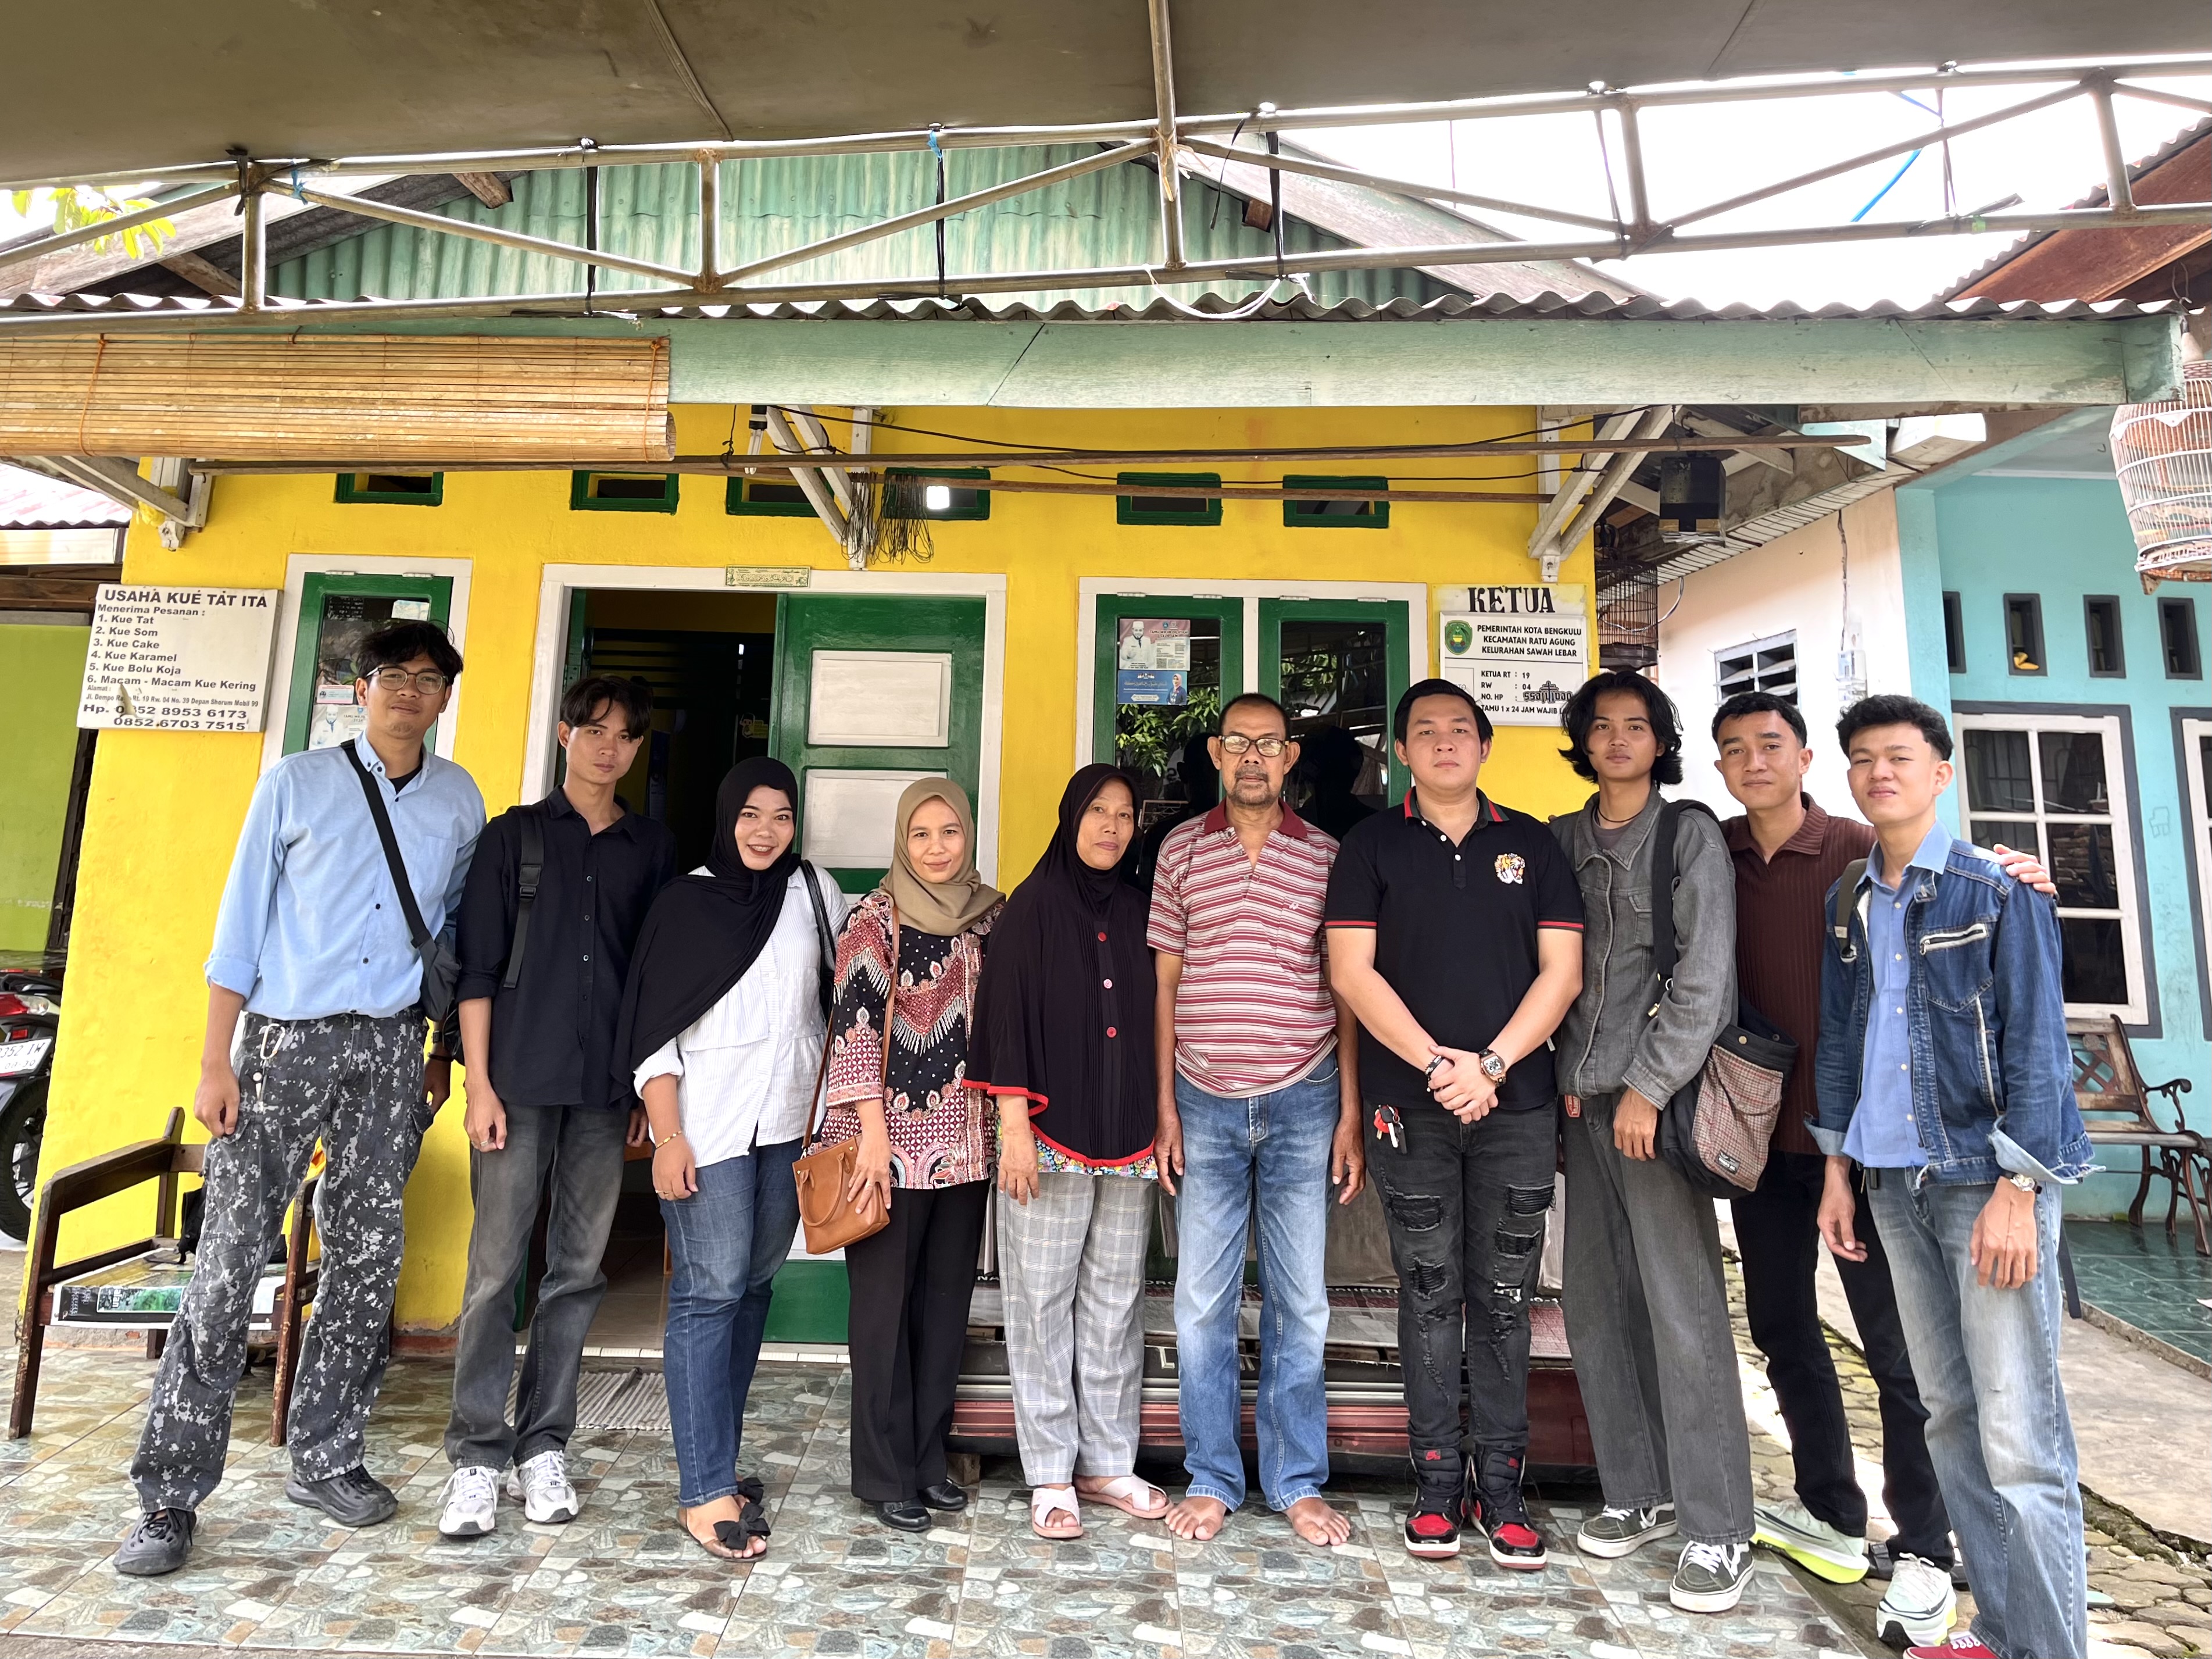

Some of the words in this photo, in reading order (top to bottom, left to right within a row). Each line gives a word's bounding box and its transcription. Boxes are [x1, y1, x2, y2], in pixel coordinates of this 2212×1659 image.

[105, 590, 160, 602] USAHA
[167, 592, 202, 604] KUE
[207, 594, 237, 606] TAT
[241, 596, 267, 608] ITA
[1467, 587, 1556, 613] KETUA
[98, 604, 149, 613] Menerima
[153, 606, 198, 615] Pesanan
[99, 614, 107, 622] 1.
[111, 615, 133, 623] Kue
[95, 626, 105, 634] 2.
[109, 627, 130, 635] Kue
[134, 628, 158, 636] Som
[1477, 625, 1522, 634] PEMERINTAH
[1544, 627, 1581, 636] BENGKULU
[107, 639, 128, 647] Kue
[132, 640, 160, 649] Cake
[1484, 636, 1527, 644] KECAMATAN
[105, 651, 126, 659] Kue
[130, 652, 177, 662] Karamel
[1482, 646, 1524, 655] KELURAHAN
[1527, 648, 1553, 656] SAWAH
[103, 663, 124, 672] Kue
[128, 664, 152, 673] Bolu
[156, 665, 181, 676] Koja
[87, 675, 97, 683] 6.
[101, 675, 141, 684] Macam
[151, 677, 191, 687] Macam
[195, 679, 216, 688] Kue
[220, 680, 256, 692] Kering
[191, 698, 209, 706] Depan
[83, 704, 109, 714] Hp.
[161, 707, 201, 716] 8953
[207, 709, 246, 719] 6173
[113, 717, 153, 726] 0852
[159, 719, 199, 729] 6703
[205, 721, 245, 730] 7515
